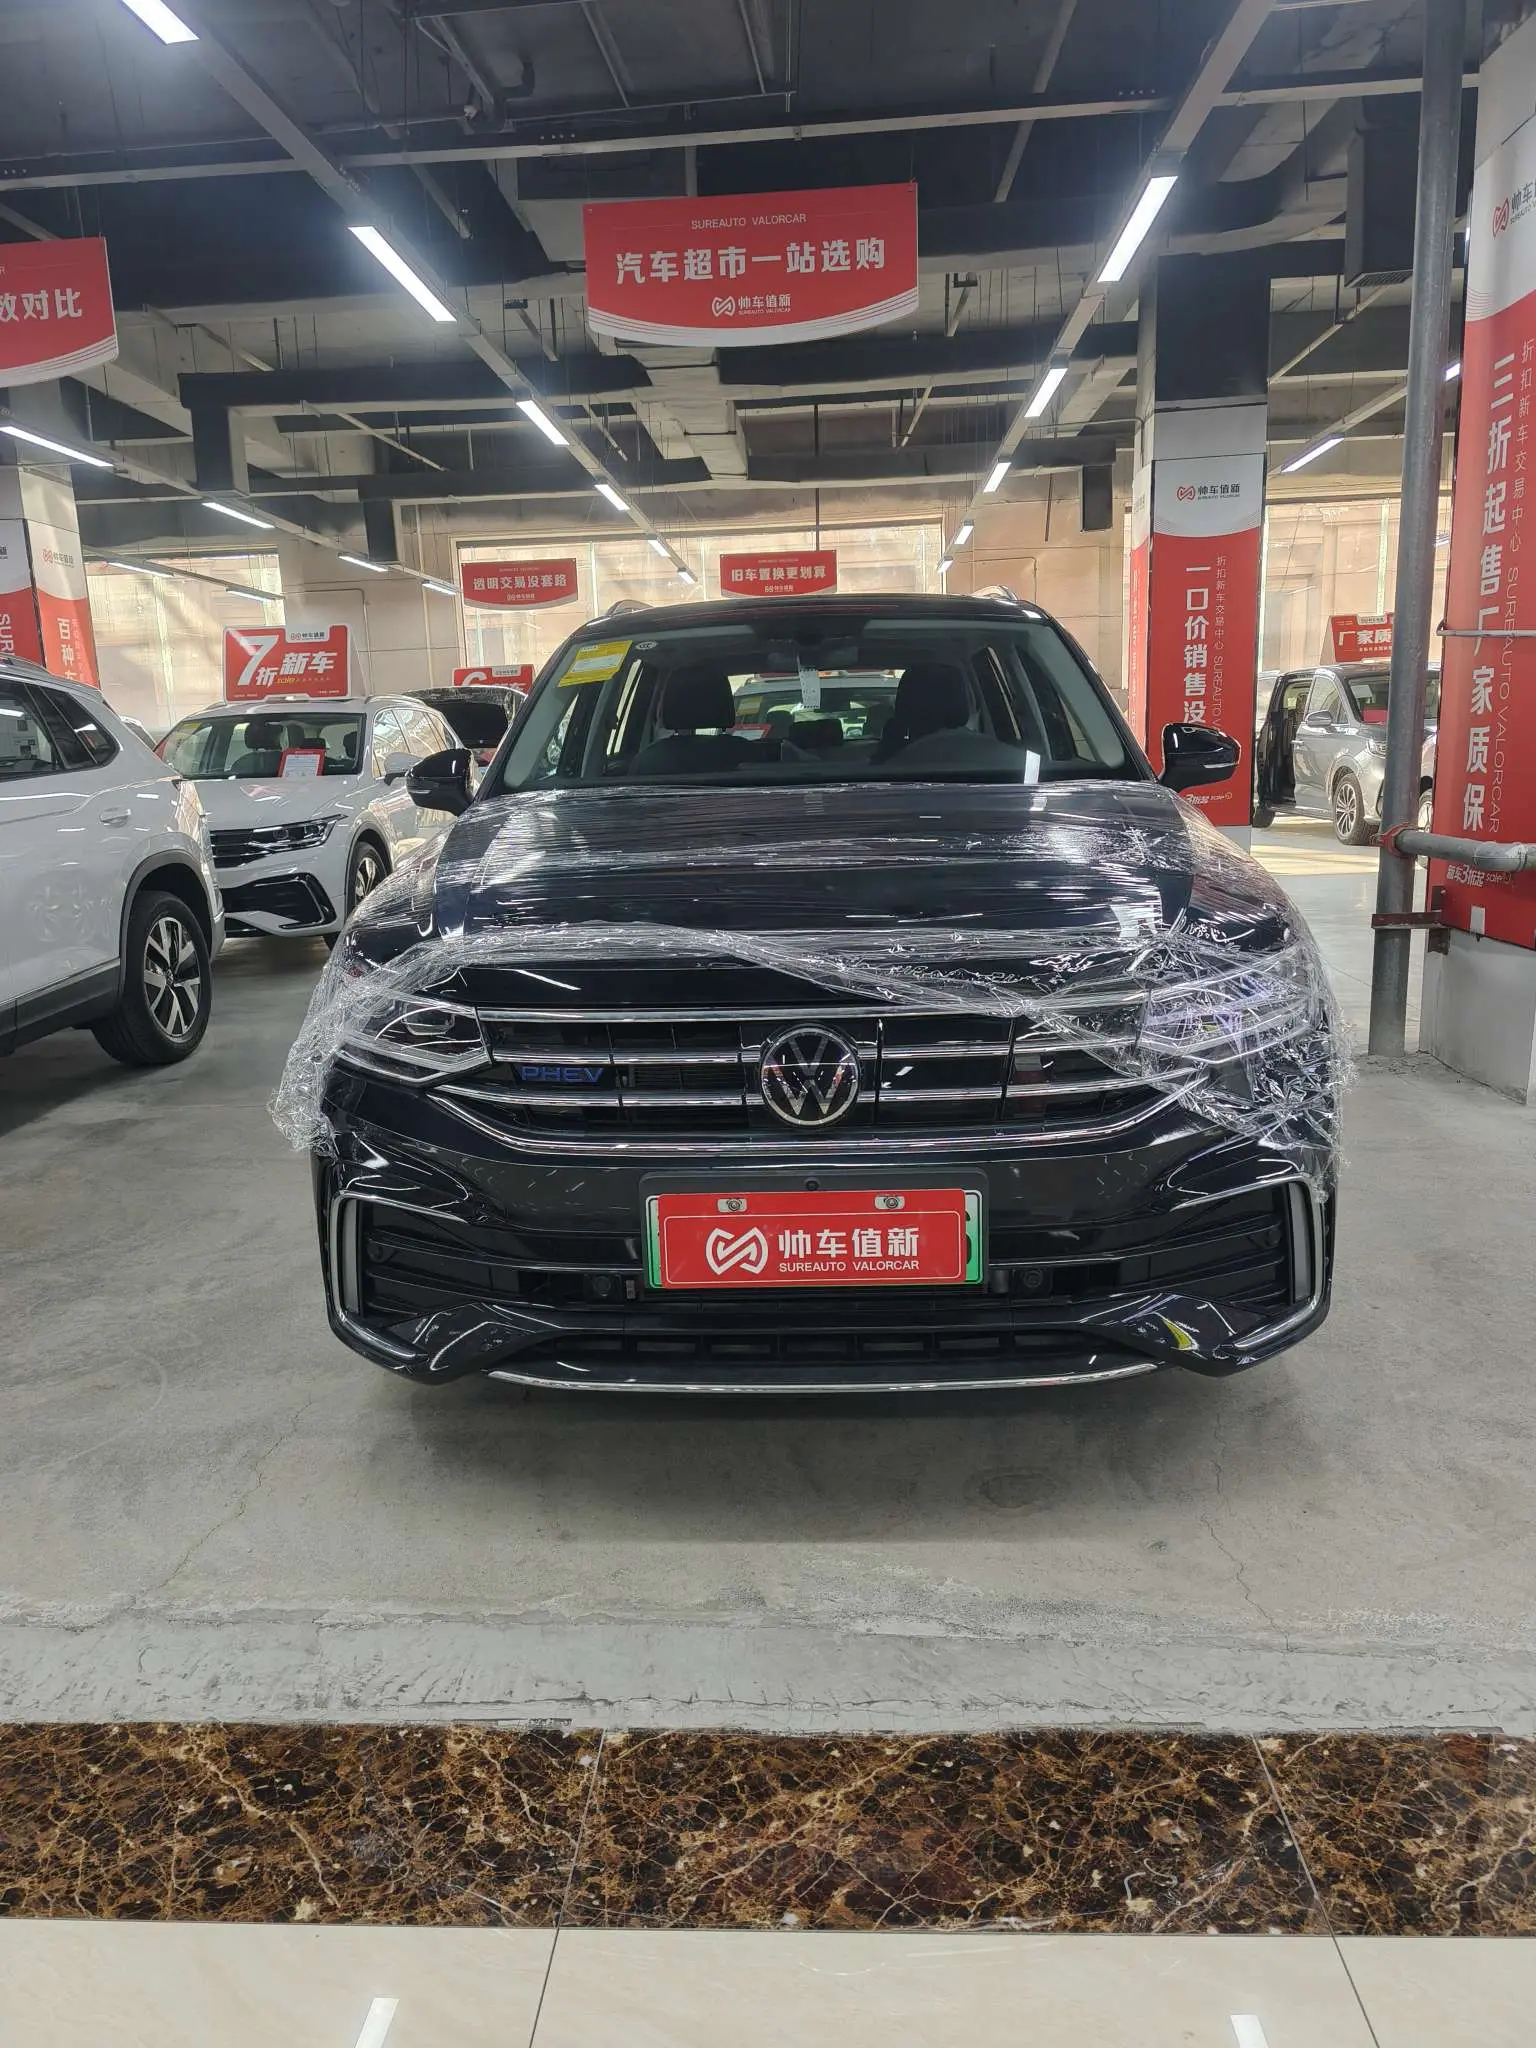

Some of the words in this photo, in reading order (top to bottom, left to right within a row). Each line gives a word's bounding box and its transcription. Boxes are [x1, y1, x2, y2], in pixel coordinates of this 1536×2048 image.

[691, 217, 746, 230] SUREAUTO
[752, 213, 807, 226] VALORCAR
[616, 237, 885, 285] 汽车超市一站选购
[1509, 338, 1535, 552] 折扣新车交易中心
[731, 565, 826, 582] 旧车置换更划算
[1463, 352, 1515, 833] 三折起售厂家质保
[1213, 555, 1228, 650] 折扣新车交易中心
[0, 614, 15, 656] SUR
[1499, 567, 1519, 700] SUREAUTO
[1211, 655, 1224, 717] SUREAUTO
[1489, 707, 1508, 833] VALORCAR
[521, 1067, 604, 1083] PHEV
[778, 1227, 920, 1260] 帅车值新
[778, 1261, 847, 1273] SUREAUTO
[852, 1260, 920, 1272] VALORCAR
